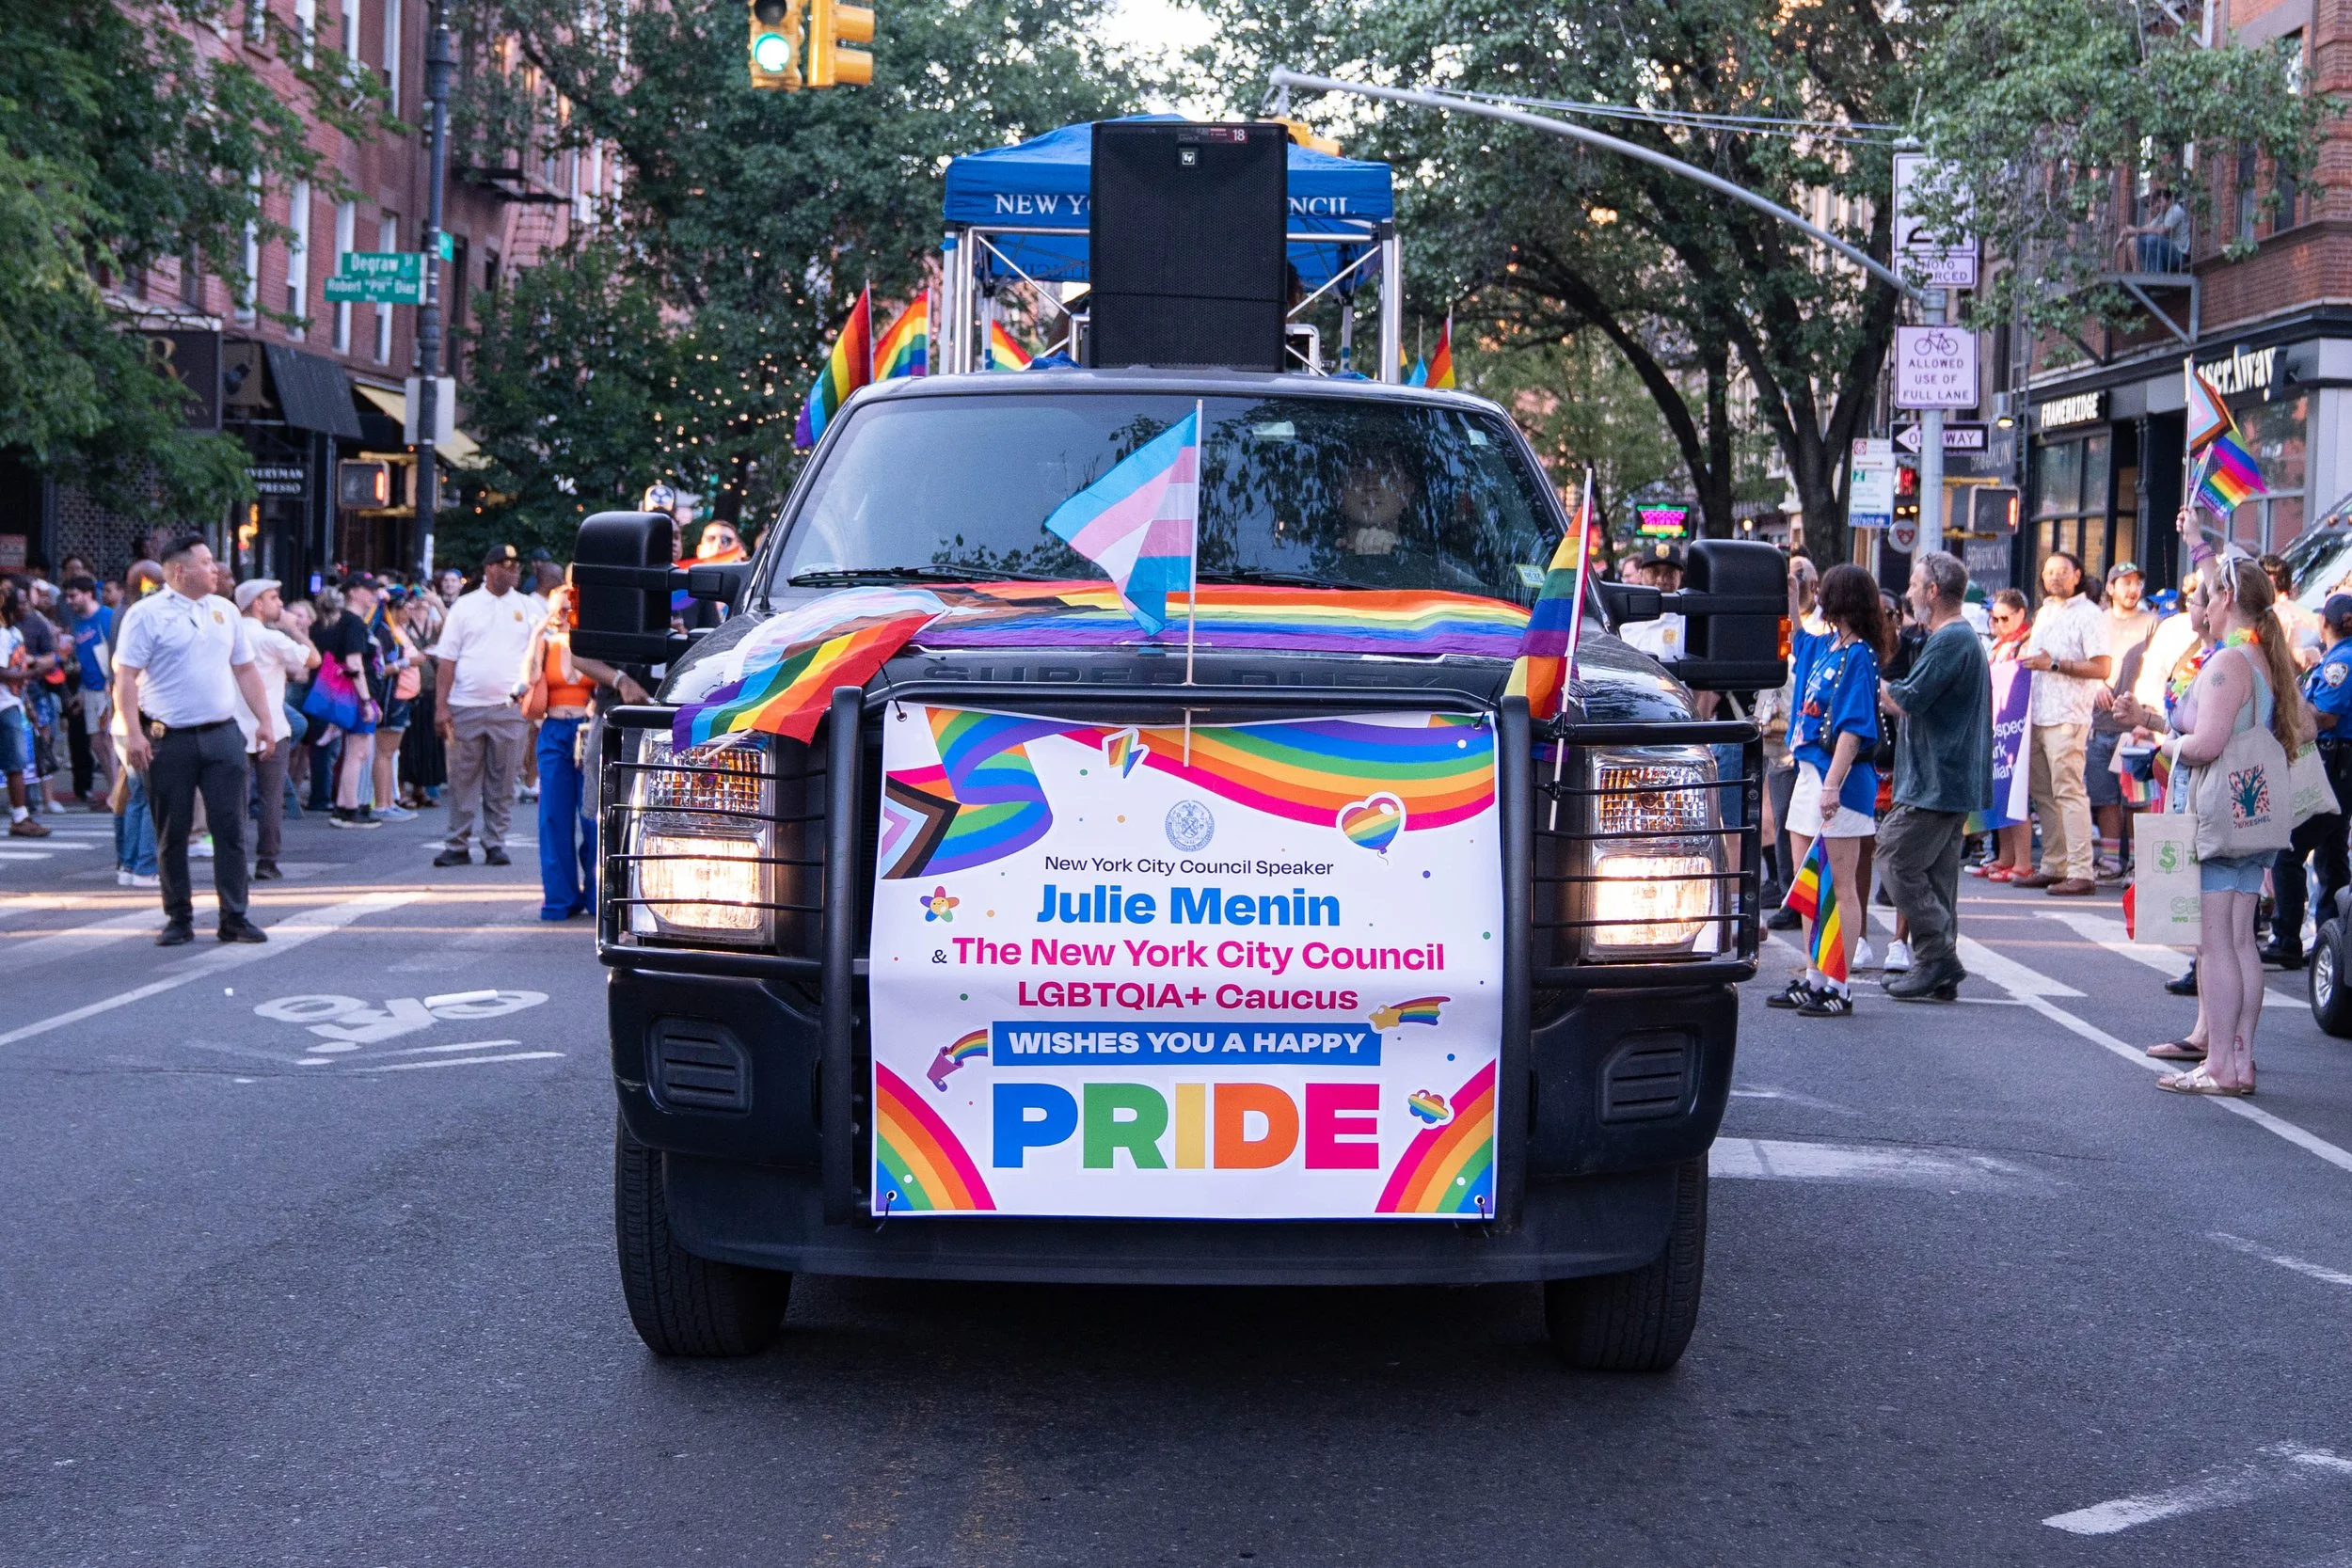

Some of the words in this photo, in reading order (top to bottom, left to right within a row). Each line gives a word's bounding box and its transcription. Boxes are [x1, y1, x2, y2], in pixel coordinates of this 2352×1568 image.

[1232, 129, 1246, 141] 18
[994, 194, 1058, 214] NEW
[1286, 197, 1355, 216] NCIL
[351, 253, 399, 276] Degraw
[1908, 358, 1964, 369] ALLOWED
[1915, 374, 1937, 385] USE
[1942, 374, 1958, 385] OF
[1903, 390, 1933, 401] FULL
[1938, 390, 1969, 401] LANE
[2041, 391, 2099, 428] FRAMEBRIDGE
[1946, 434, 1975, 444] WAY
[255, 483, 301, 495] PRESSO
[1993, 717, 2026, 739] spec
[1045, 856, 1088, 871] New
[1091, 857, 1133, 873] York
[1136, 858, 1176, 877] City
[1180, 859, 1251, 875] Council
[1256, 860, 1334, 877] Speaker
[1037, 884, 1156, 925] Julie
[1170, 887, 1341, 926] Menin
[931, 949, 947, 964] &
[952, 937, 1022, 965] The
[1031, 939, 1116, 966] New
[1123, 940, 1209, 968] York
[1217, 941, 1294, 975] City
[1302, 942, 1445, 971] Council
[1018, 981, 1207, 1011] LGBTQIA+
[1216, 983, 1359, 1010] Caucus
[1009, 1031, 1139, 1054] WISHES
[1146, 1032, 1215, 1054] YOU
[1221, 1033, 1247, 1053] A
[1253, 1033, 1367, 1053] HAPPY
[992, 1083, 1380, 1169] PRIDE
